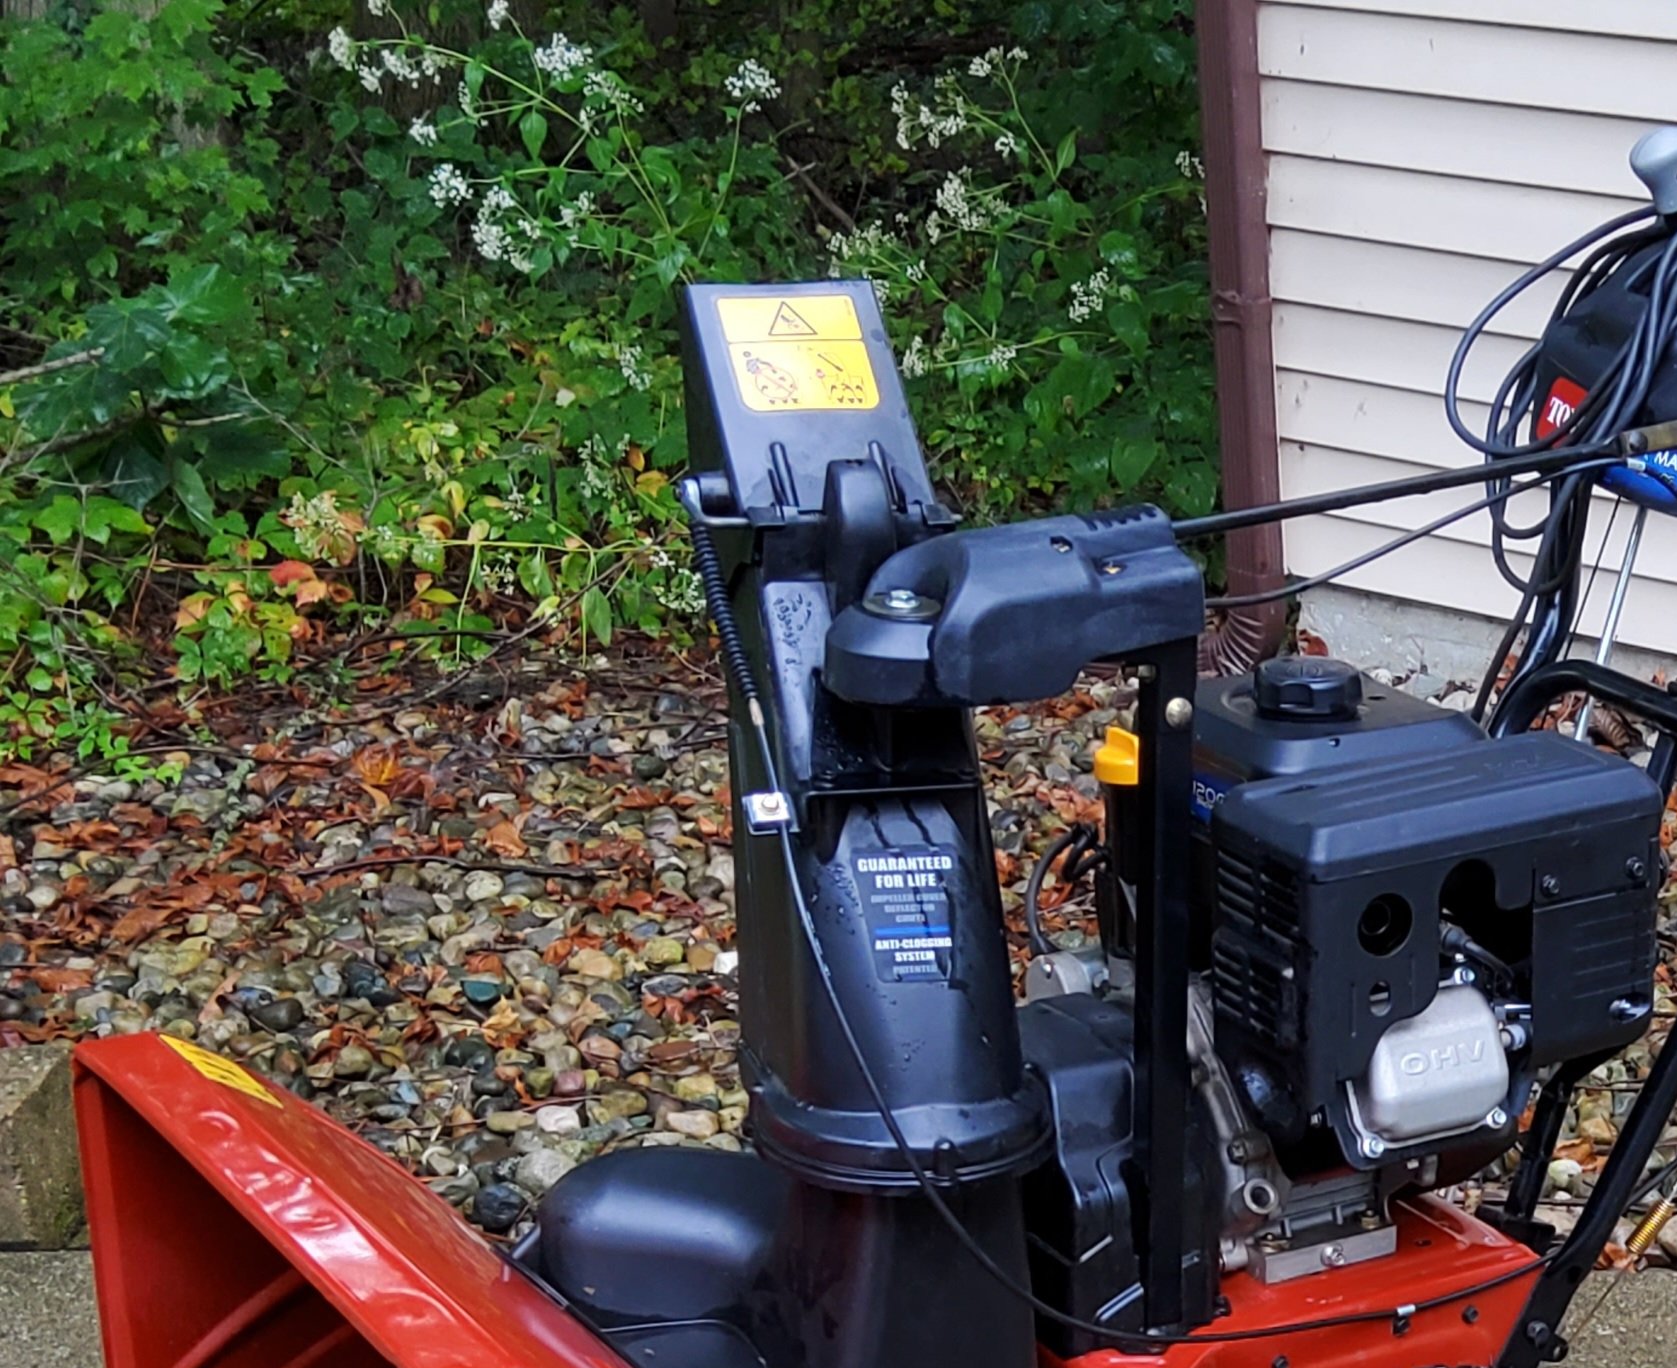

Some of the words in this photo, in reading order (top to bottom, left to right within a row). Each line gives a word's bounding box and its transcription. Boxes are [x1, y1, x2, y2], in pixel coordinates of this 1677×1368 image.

[857, 856, 952, 872] GUARANTEED
[875, 874, 904, 888] FOR
[907, 873, 937, 887] LIFE
[894, 950, 936, 962] SYSTEM
[1400, 1039, 1484, 1075] OHV
